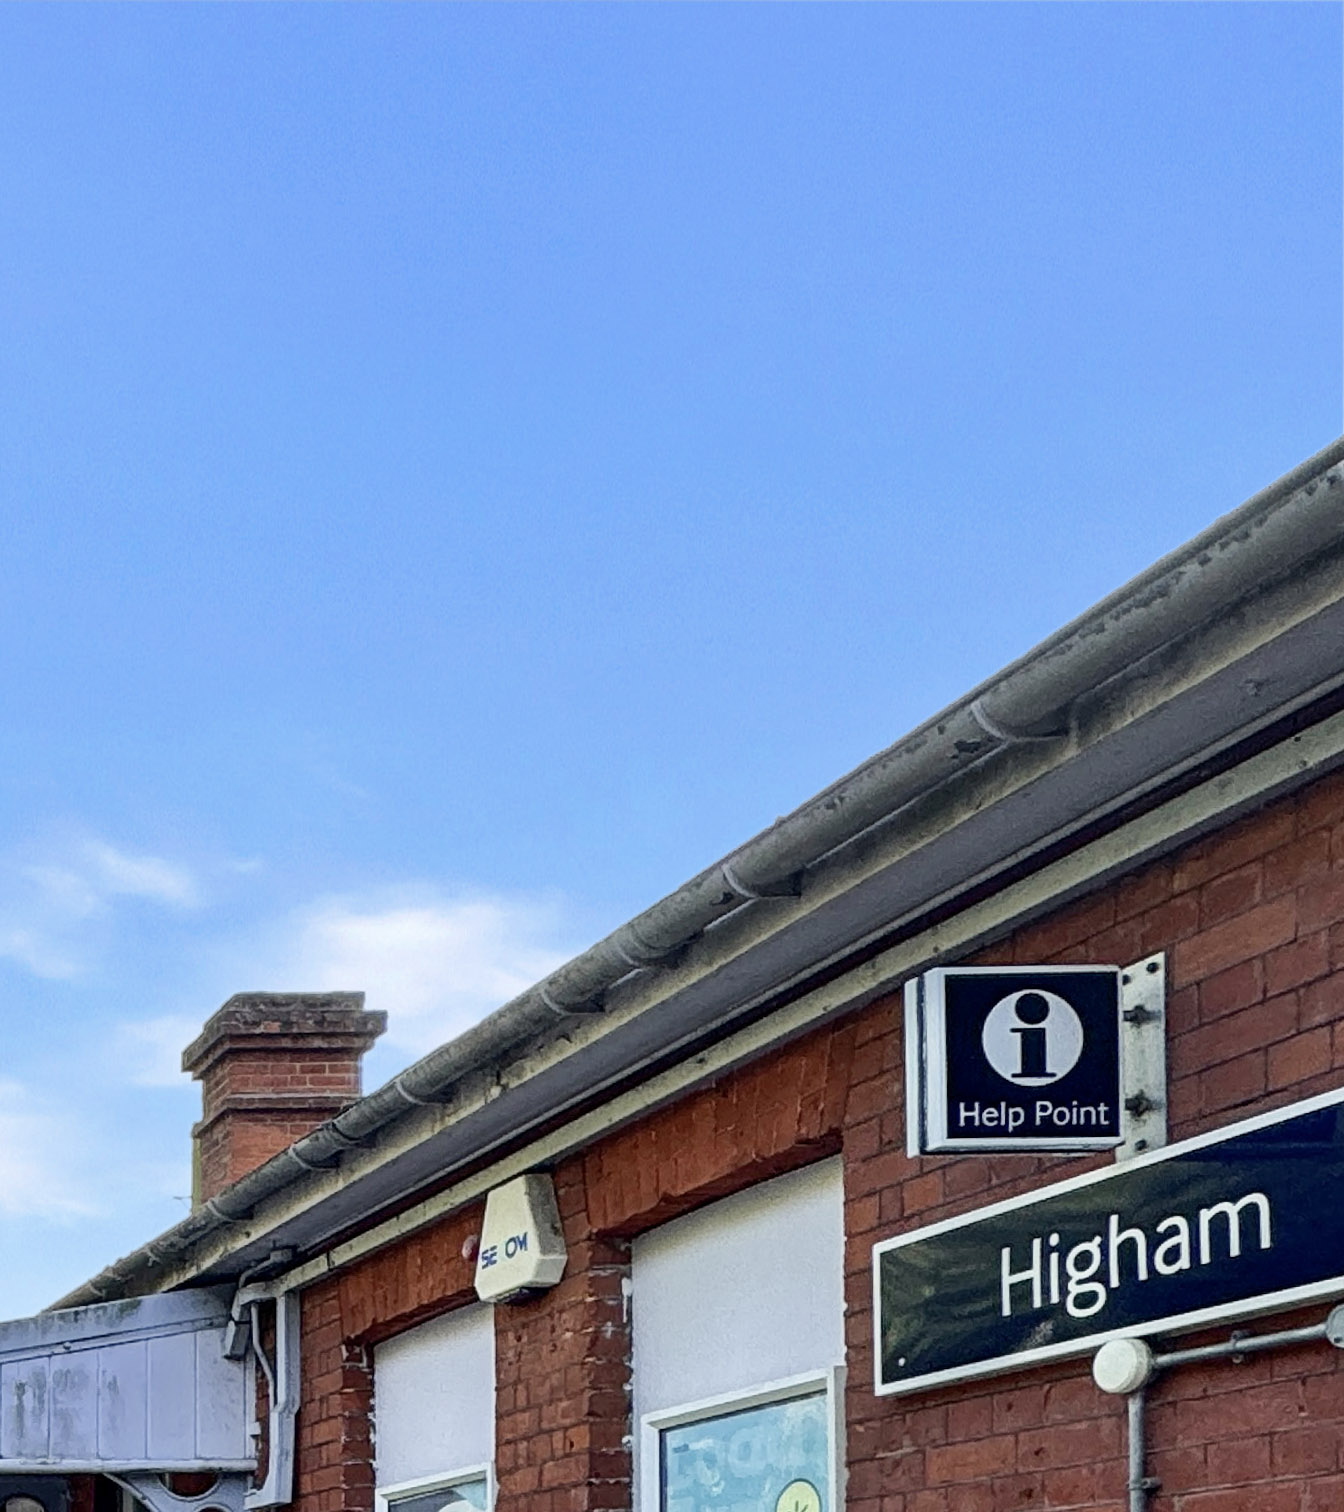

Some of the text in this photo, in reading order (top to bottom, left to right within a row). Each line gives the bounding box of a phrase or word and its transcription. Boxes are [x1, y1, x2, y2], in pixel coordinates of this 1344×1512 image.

[958, 1100, 1110, 1132] Help Point
[1000, 1192, 1272, 1319] Higham
